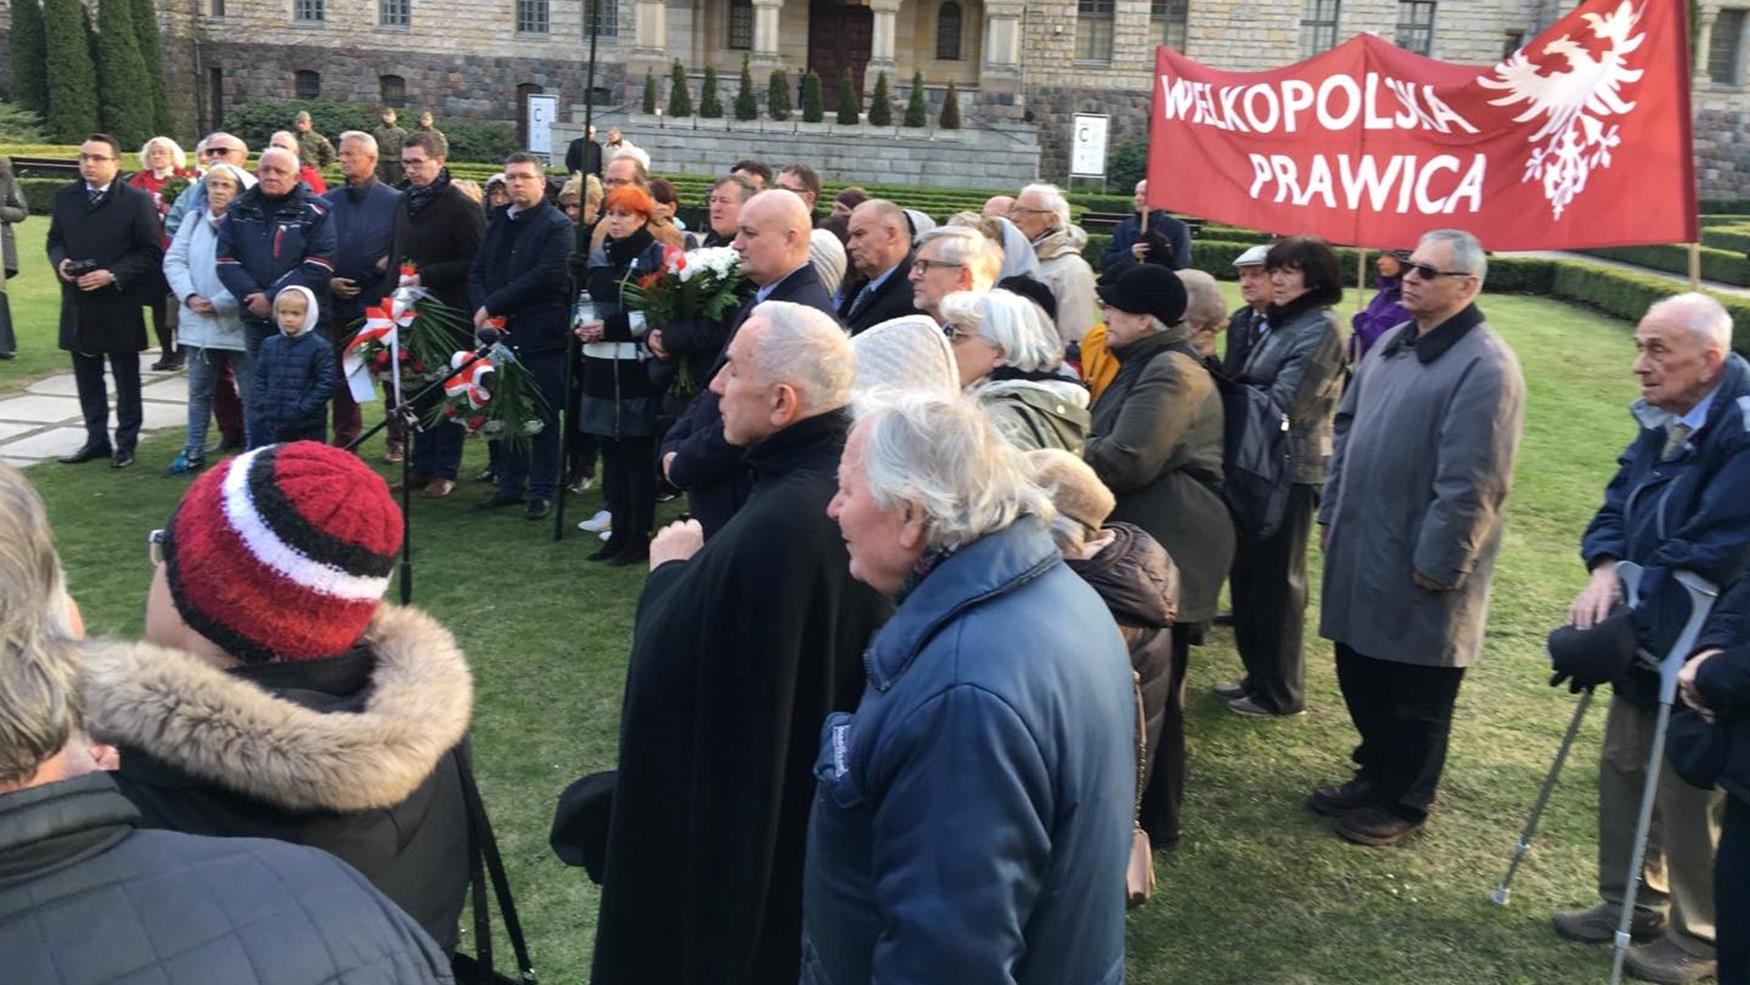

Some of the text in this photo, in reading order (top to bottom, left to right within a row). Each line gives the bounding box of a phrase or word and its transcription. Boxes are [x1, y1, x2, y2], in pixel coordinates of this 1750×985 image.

[534, 108, 542, 122] C
[1079, 127, 1089, 142] C
[1250, 153, 1486, 214] PRAWICA
